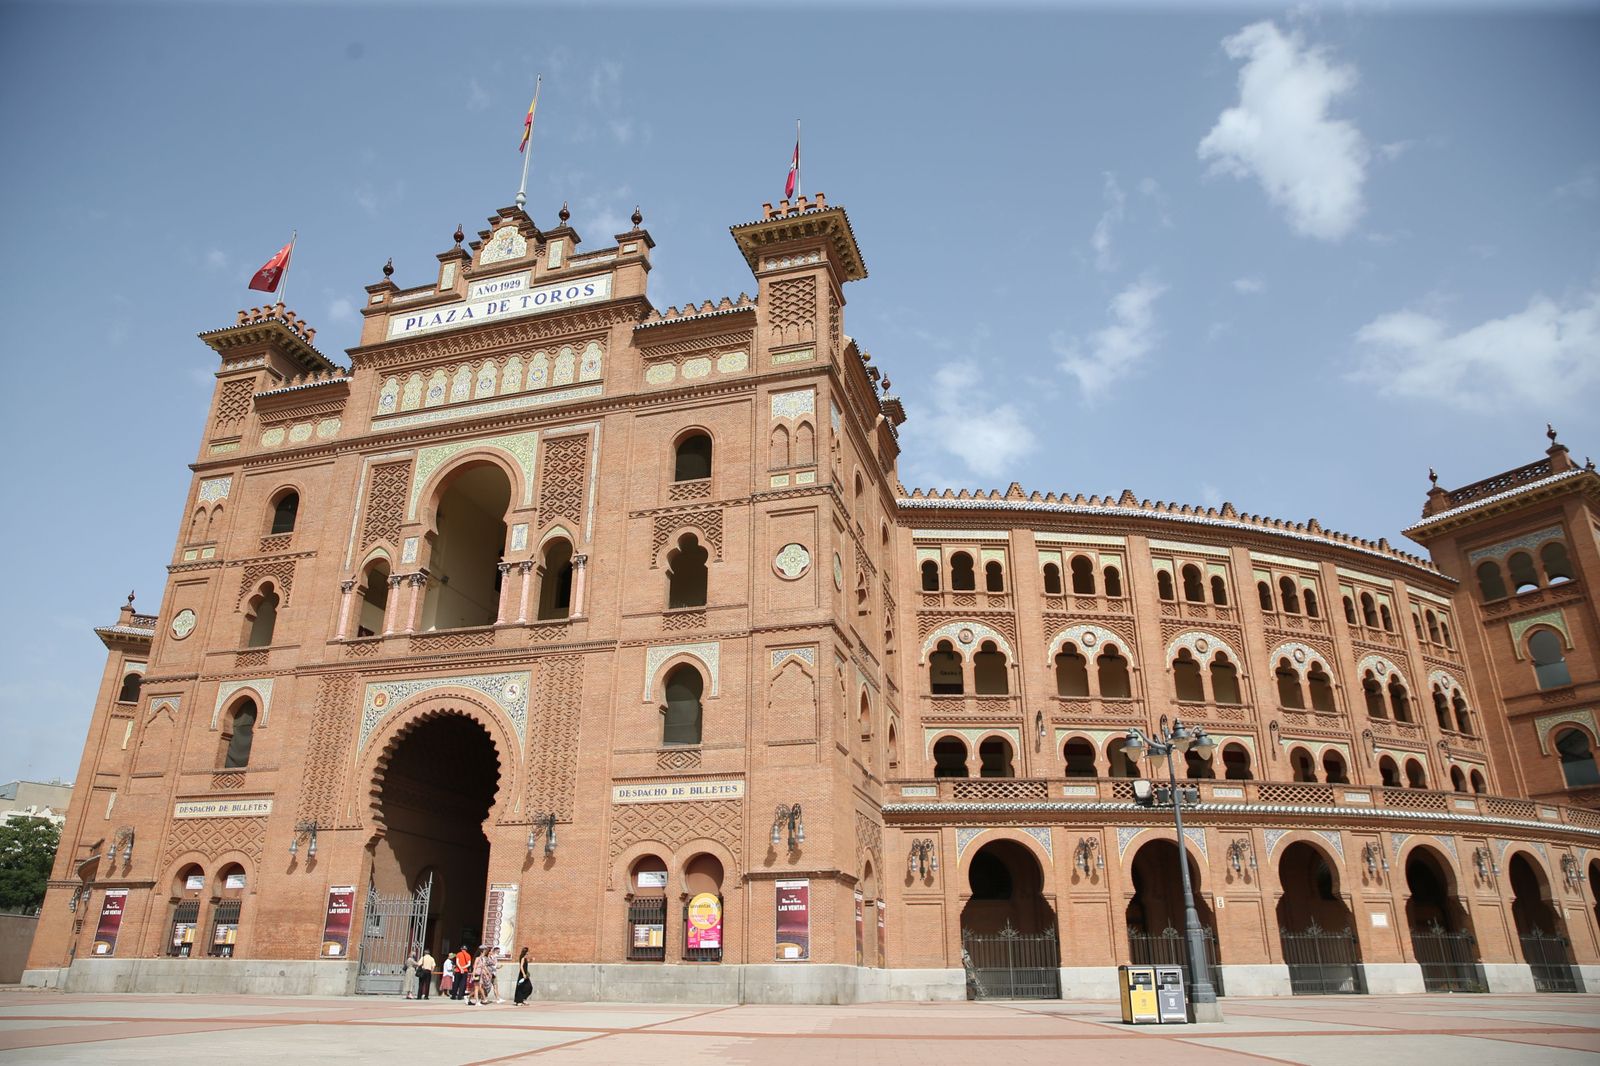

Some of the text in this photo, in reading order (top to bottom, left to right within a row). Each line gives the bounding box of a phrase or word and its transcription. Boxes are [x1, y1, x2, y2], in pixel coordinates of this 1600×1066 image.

[476, 280, 521, 296] AÑO 1929
[405, 283, 595, 331] PLAZA DE TOROS
[619, 788, 667, 797] DESPACHO
[690, 785, 738, 794] BILLETES
[231, 803, 268, 811] BILLETES
